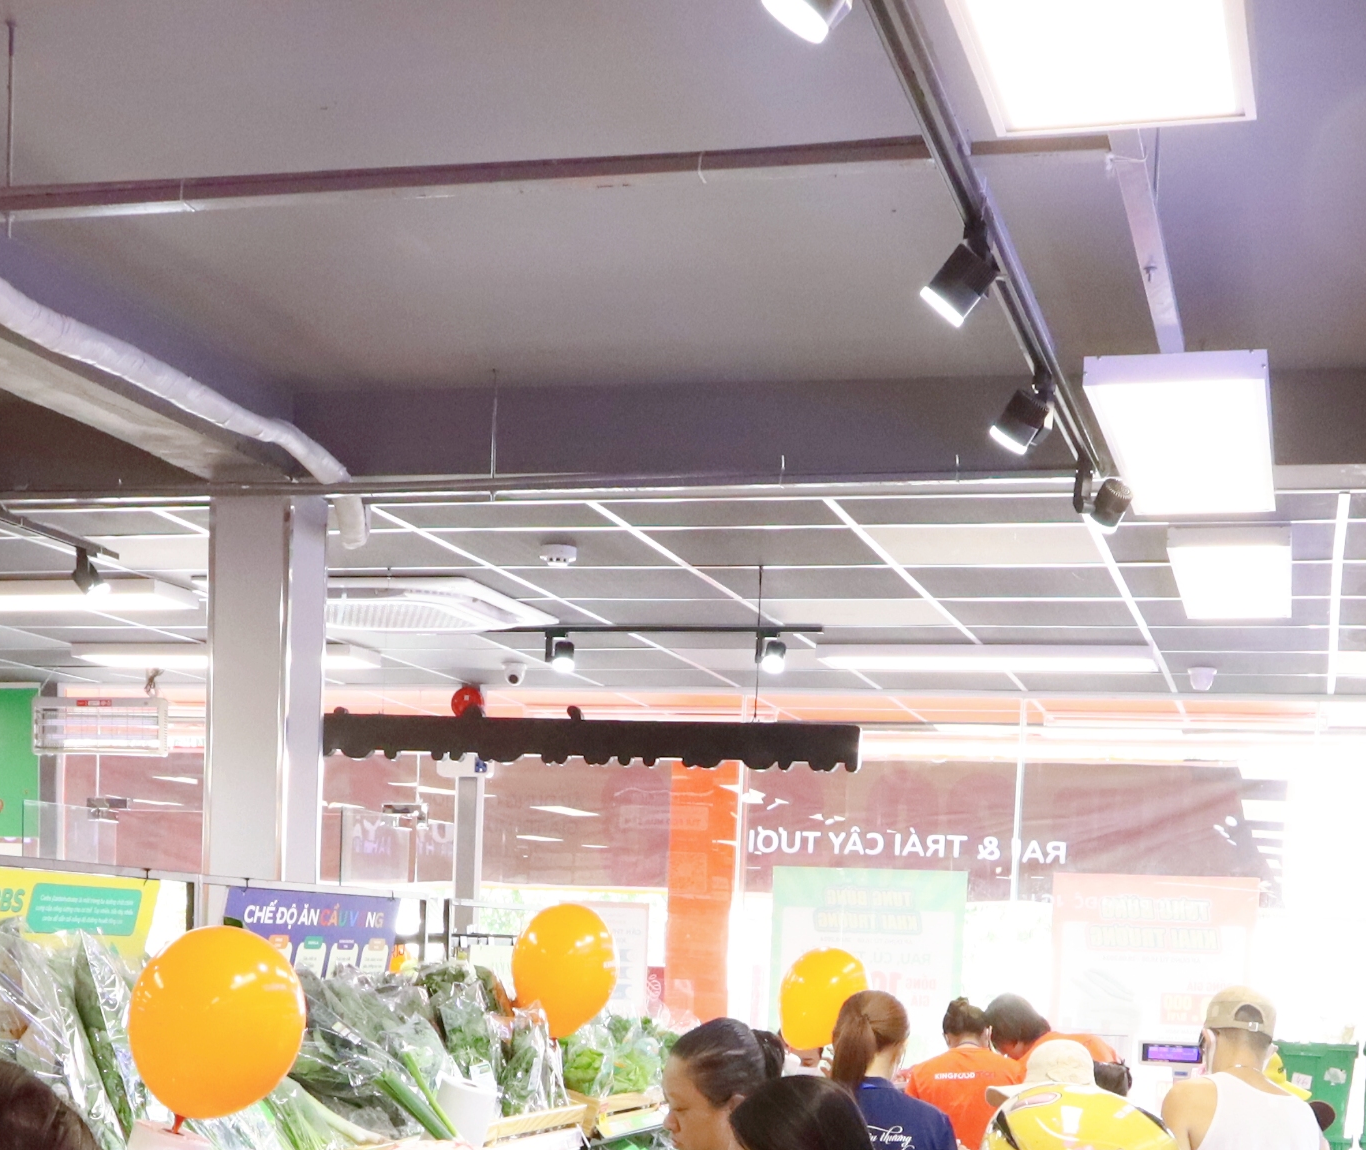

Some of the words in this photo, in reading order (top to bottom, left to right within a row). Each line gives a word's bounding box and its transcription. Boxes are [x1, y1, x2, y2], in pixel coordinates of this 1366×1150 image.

[243, 900, 277, 924] CHẾ
[275, 904, 297, 930] ĐỘ
[298, 903, 320, 926] ĂN
